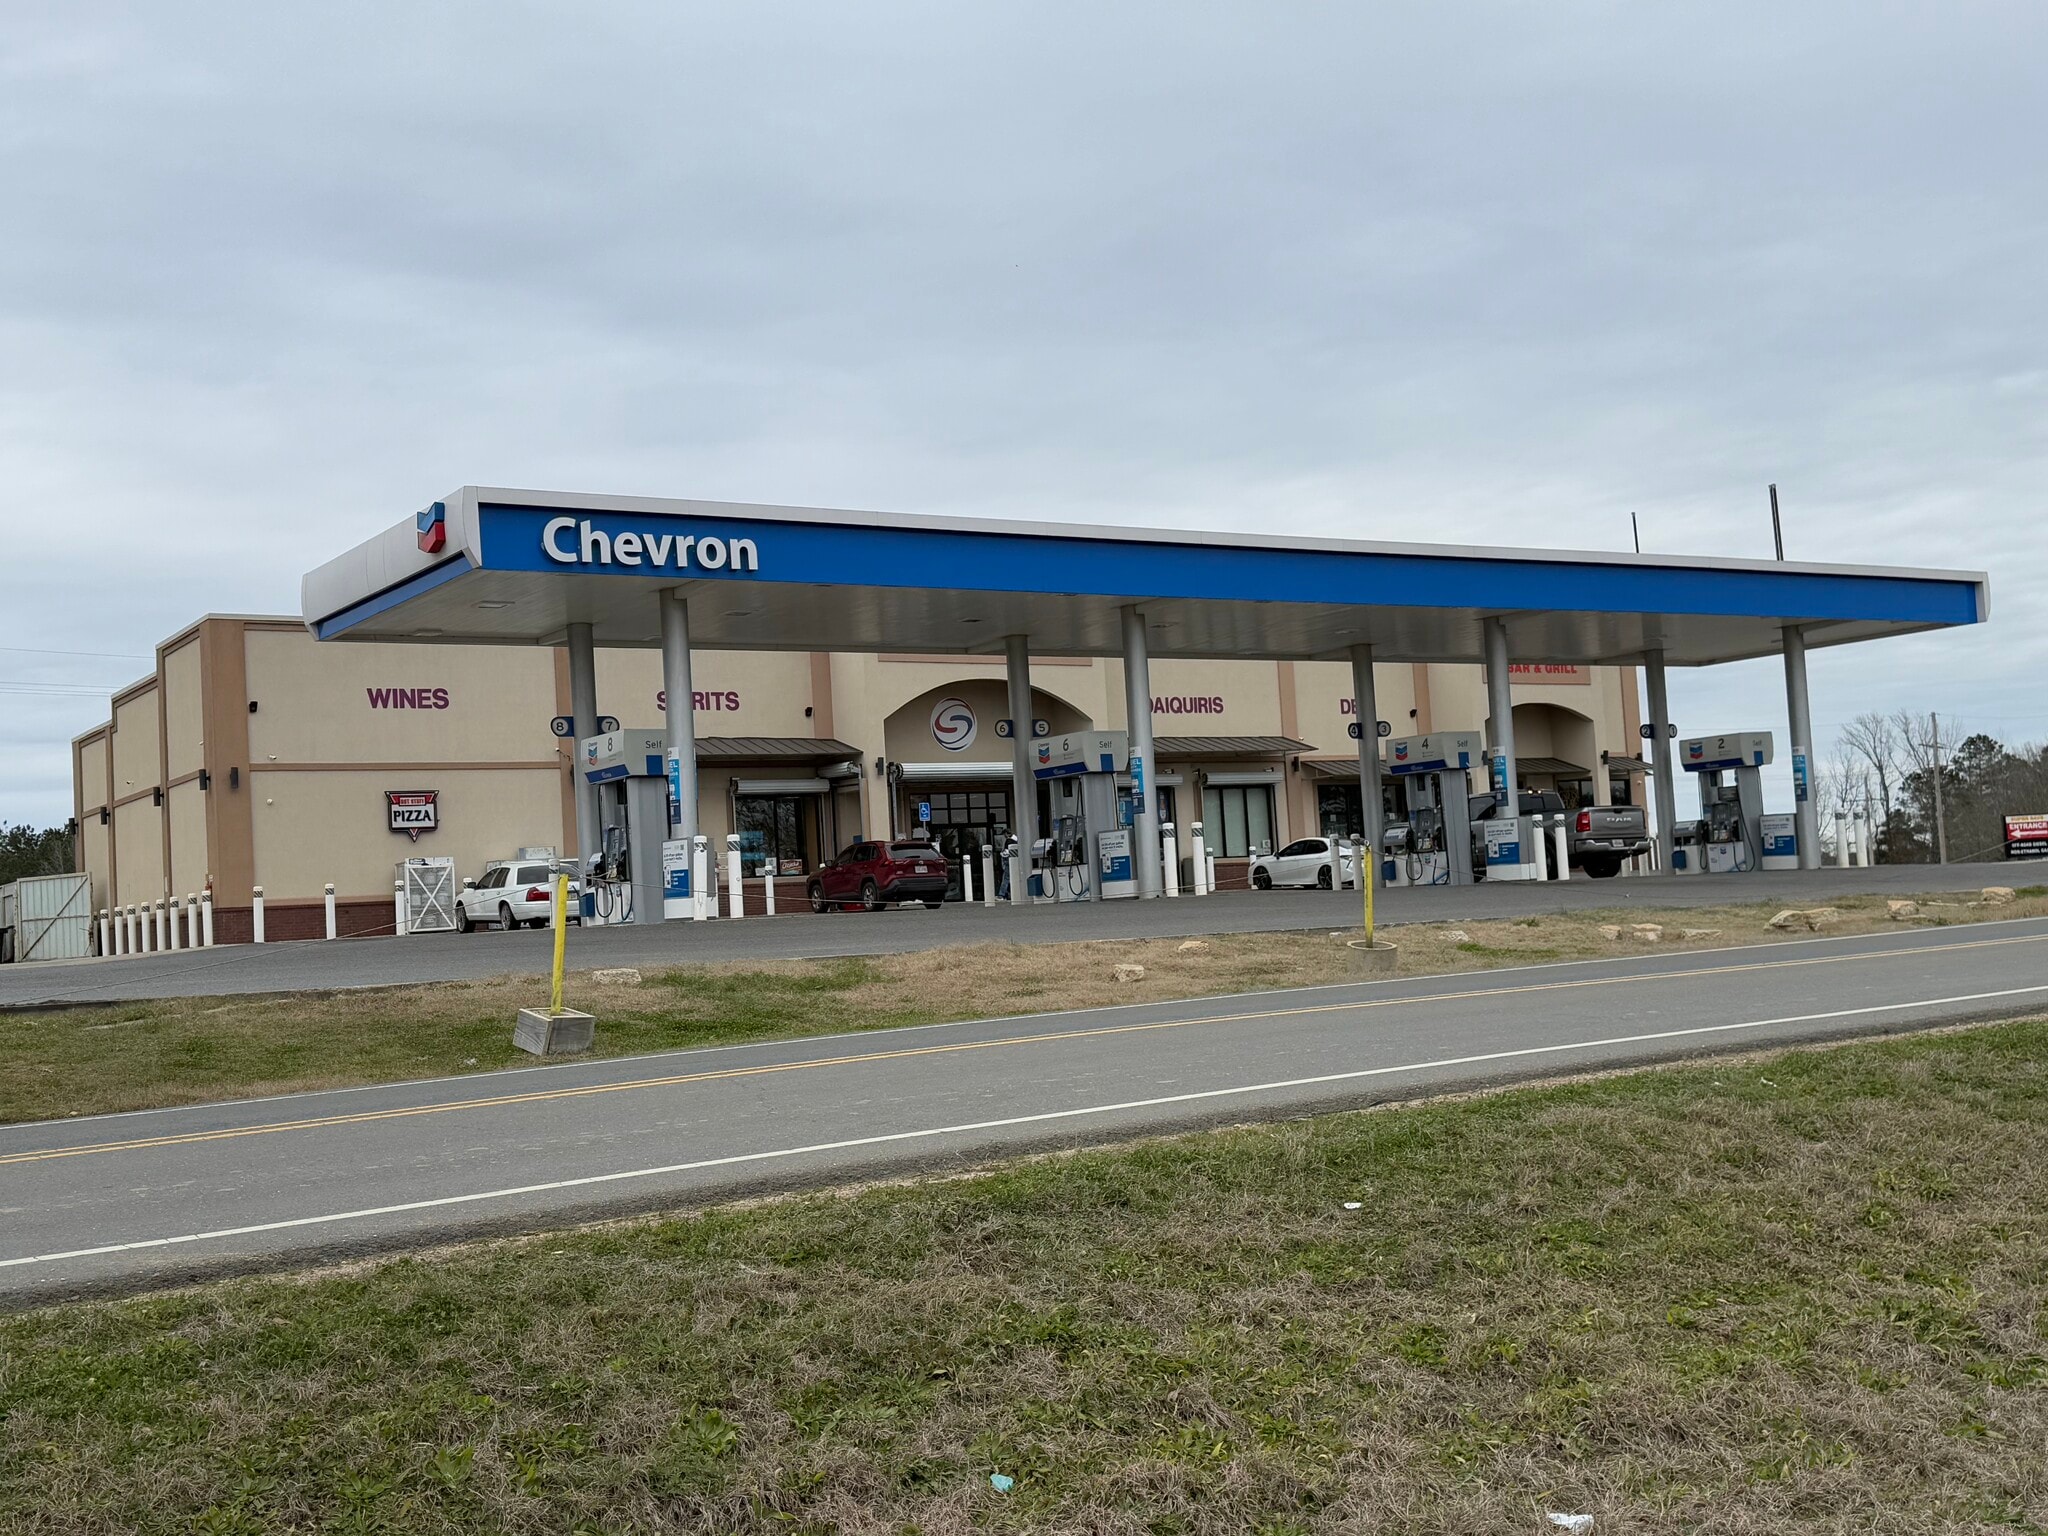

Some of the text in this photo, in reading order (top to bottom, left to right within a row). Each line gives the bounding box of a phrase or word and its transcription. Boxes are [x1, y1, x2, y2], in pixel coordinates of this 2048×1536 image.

[543, 516, 758, 571] Chevron
[366, 688, 450, 709] WINES
[656, 690, 740, 711] SRITS
[1150, 696, 1224, 714] AIQUIRIS
[556, 721, 564, 731] 8
[605, 721, 613, 731] 7
[999, 724, 1006, 733] 6
[1038, 723, 1046, 732] 5
[1351, 726, 1357, 735] 4
[1381, 725, 1387, 733] 3
[1643, 726, 1649, 735] 2
[607, 737, 613, 752] 8
[645, 740, 662, 749] Self
[1062, 738, 1069, 751] 6
[1099, 740, 1112, 749] Self
[1421, 738, 1429, 749] 4
[1457, 740, 1468, 748] Self
[1718, 738, 1725, 749] 2
[393, 809, 432, 823] PIZZA
[2009, 822, 2048, 830] ENTRANCE
